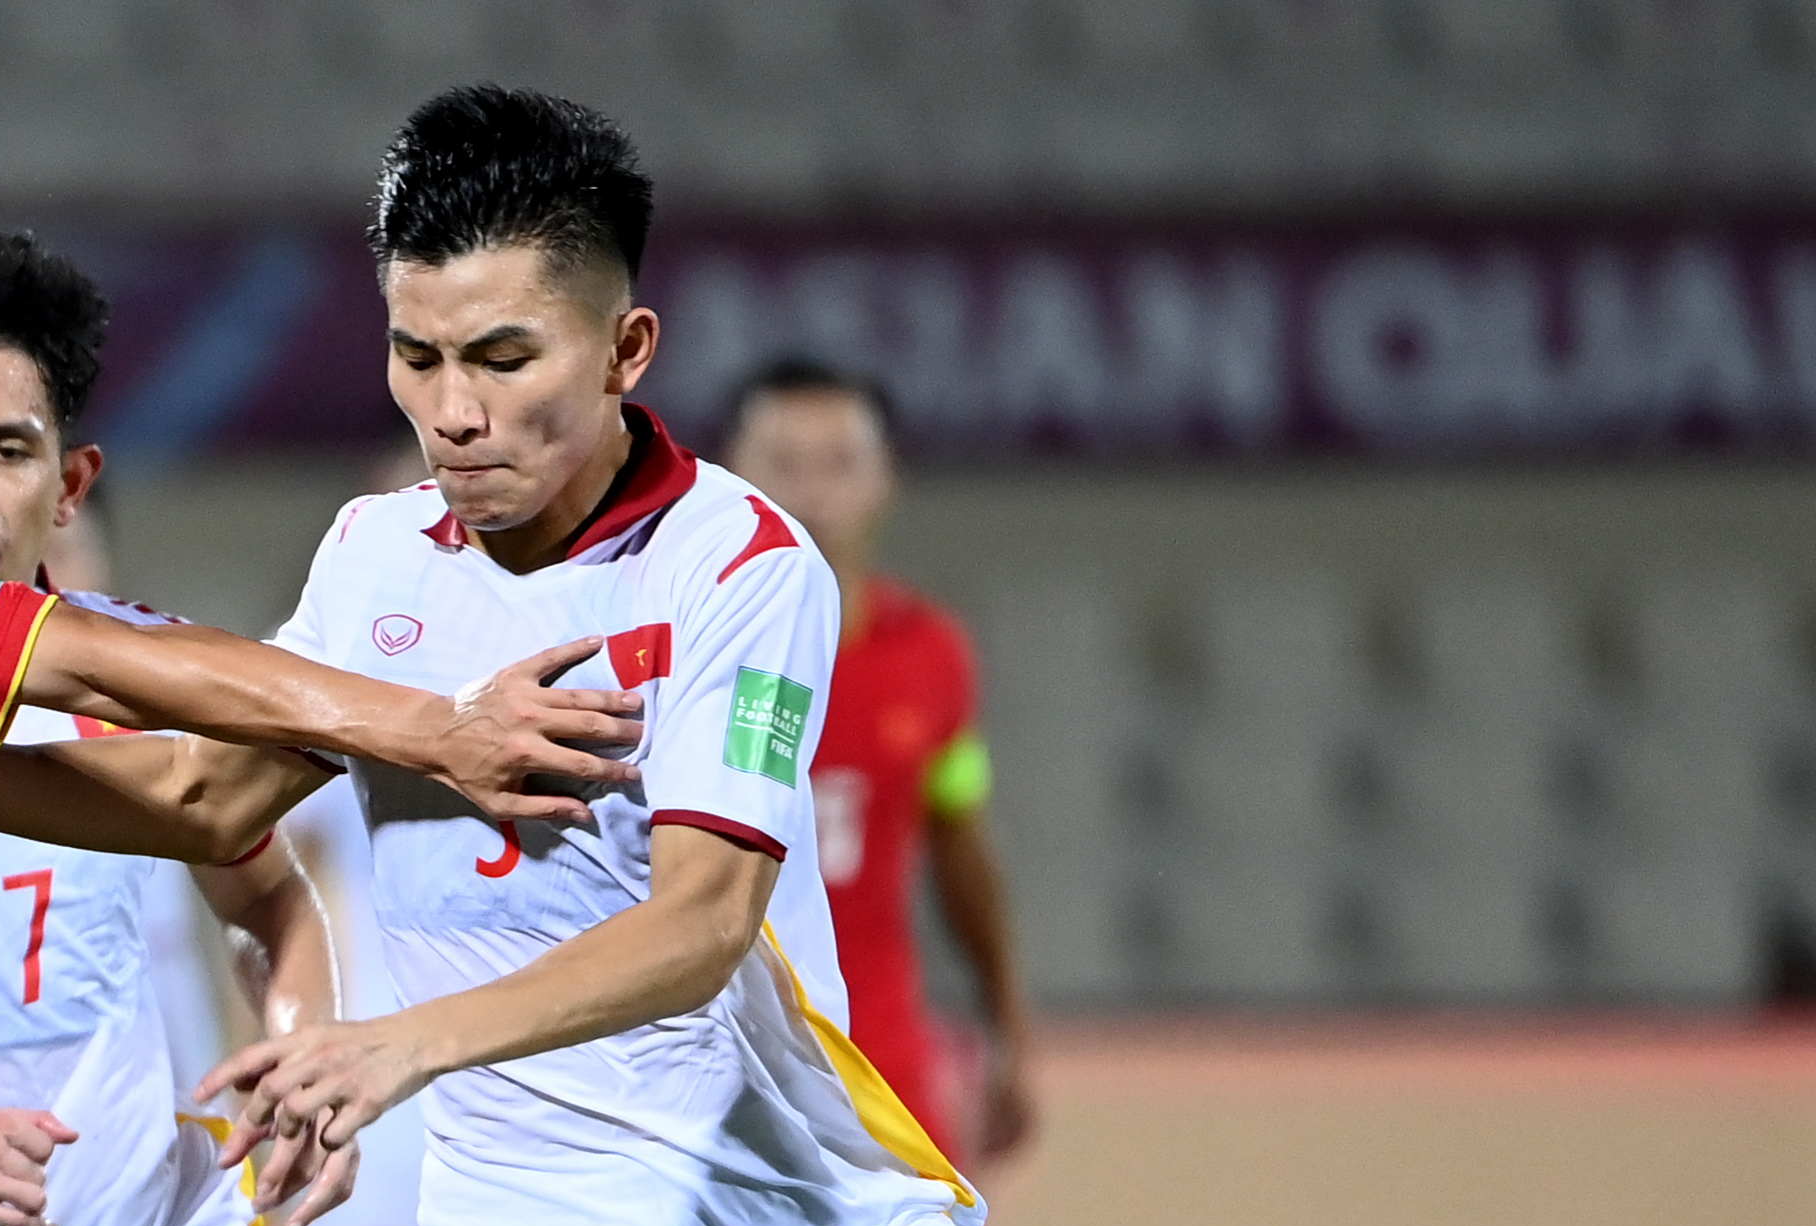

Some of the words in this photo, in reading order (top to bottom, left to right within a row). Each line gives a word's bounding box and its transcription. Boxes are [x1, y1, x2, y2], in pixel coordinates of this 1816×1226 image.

[736, 708, 796, 736] FOOTBALL
[738, 696, 801, 724] LIVING
[771, 739, 793, 759] FIFA
[2, 868, 53, 1005] 7
